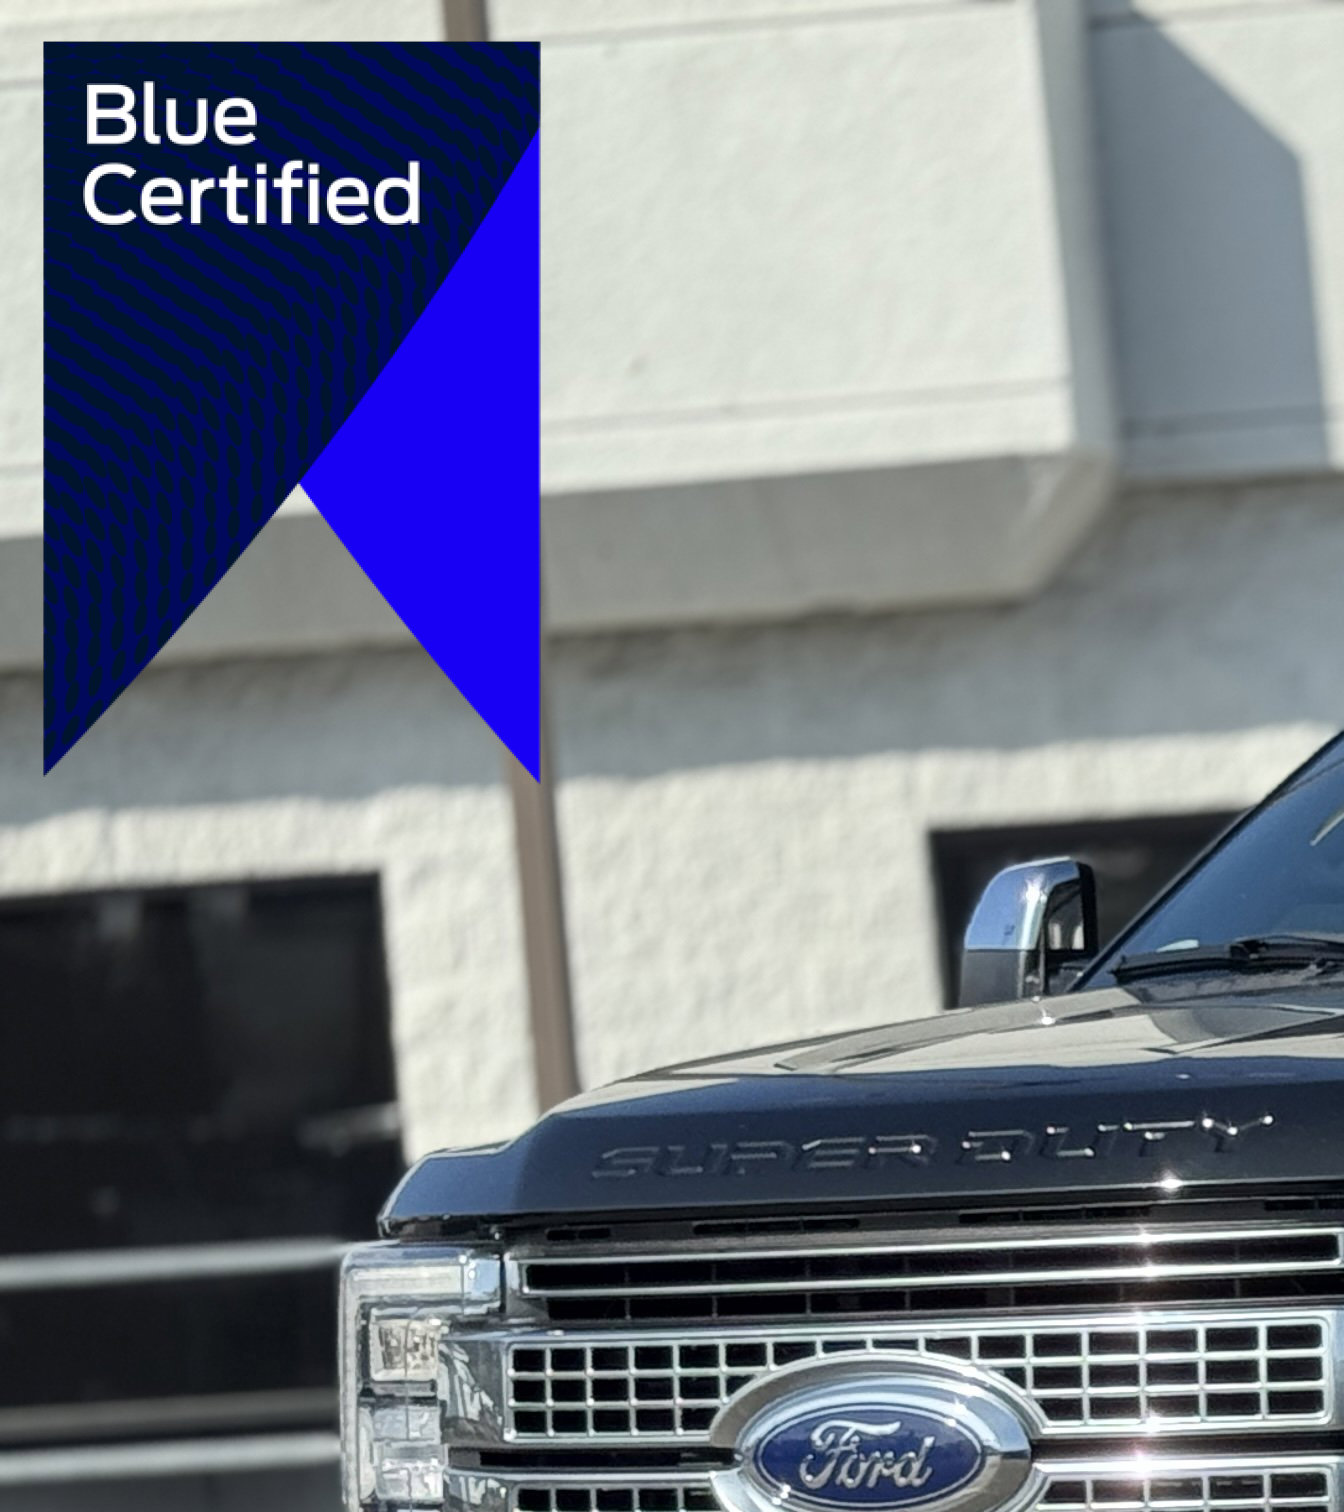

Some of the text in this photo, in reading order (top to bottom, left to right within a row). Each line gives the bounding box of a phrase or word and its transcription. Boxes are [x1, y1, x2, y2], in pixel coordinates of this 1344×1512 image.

[592, 1114, 1278, 1180] SUPER DUTY
[798, 1418, 936, 1491] Ford
